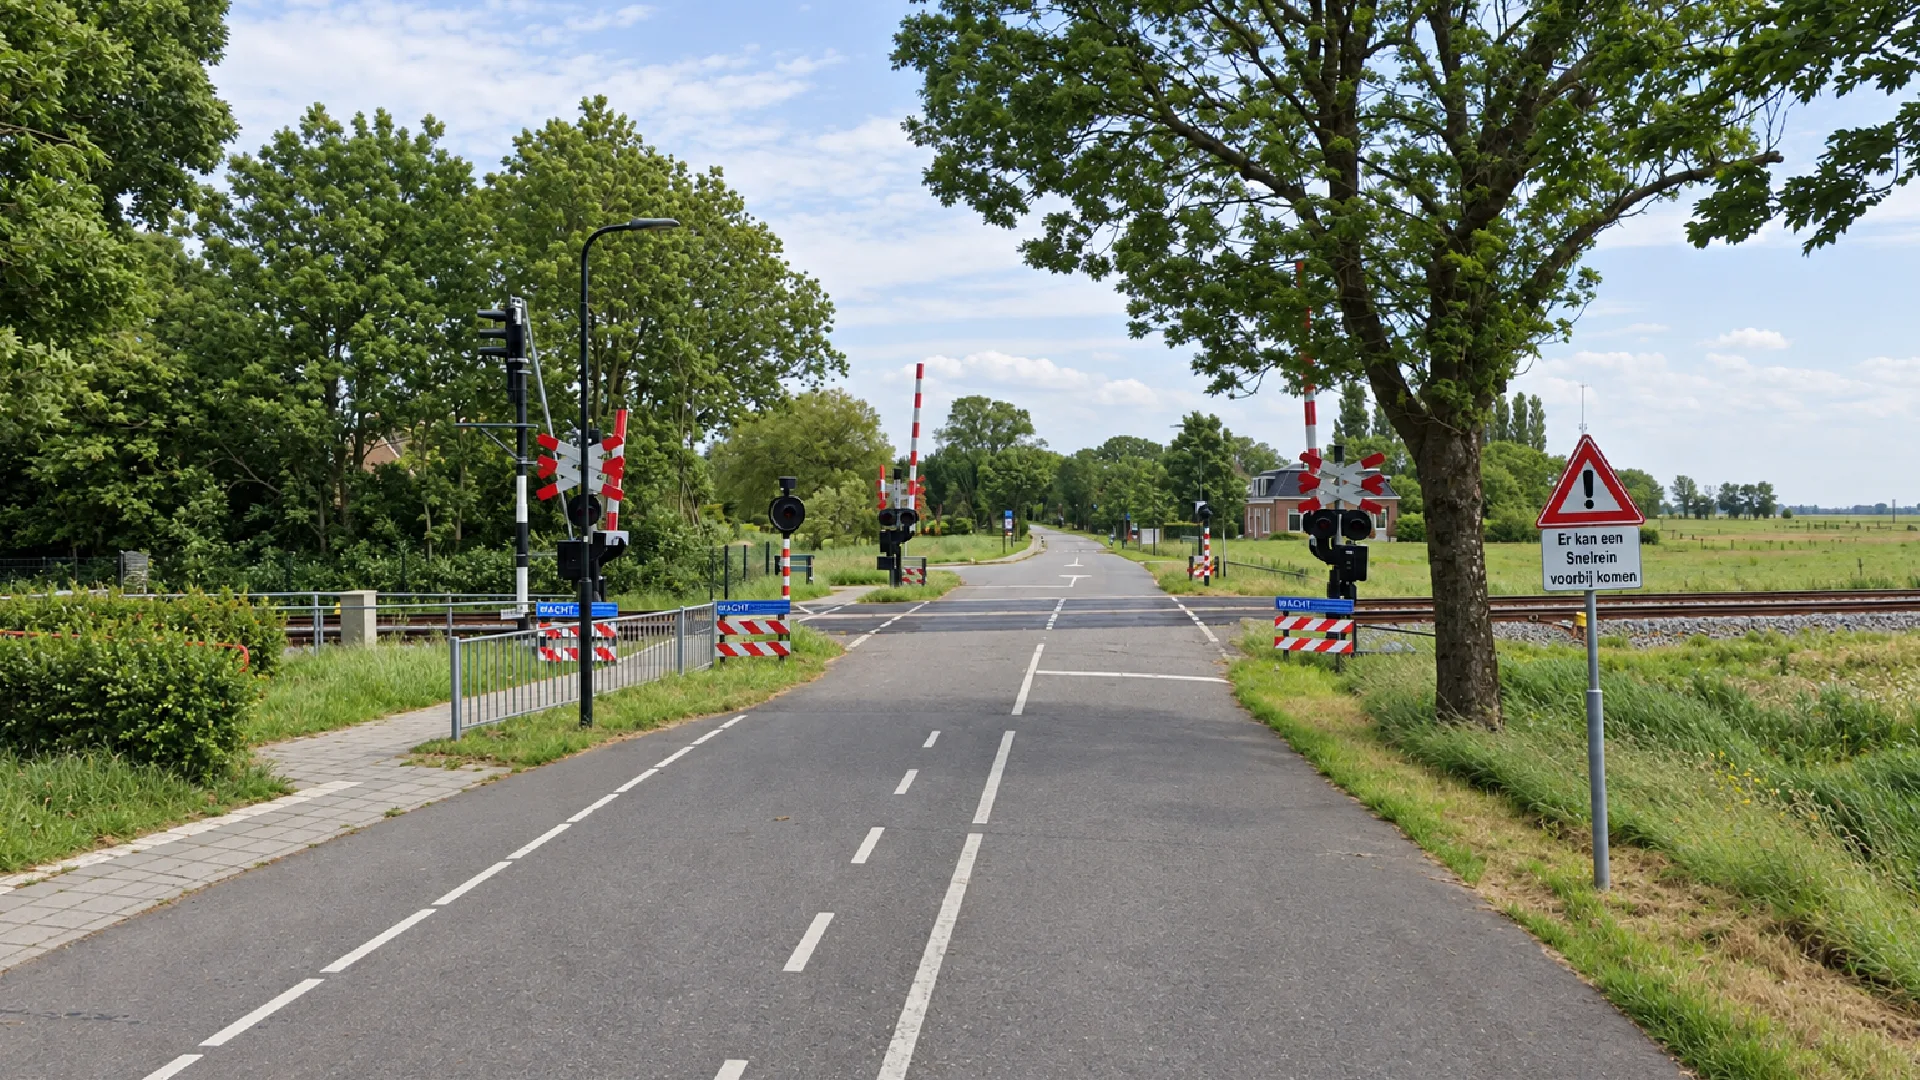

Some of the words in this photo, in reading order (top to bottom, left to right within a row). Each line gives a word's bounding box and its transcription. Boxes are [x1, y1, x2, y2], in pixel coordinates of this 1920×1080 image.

[1557, 533, 1571, 546] Er
[1575, 532, 1597, 545] kan
[1601, 534, 1623, 545] een
[1566, 550, 1617, 565] Snelrein
[1550, 571, 1593, 587] voorbij
[1597, 570, 1637, 583] komen
